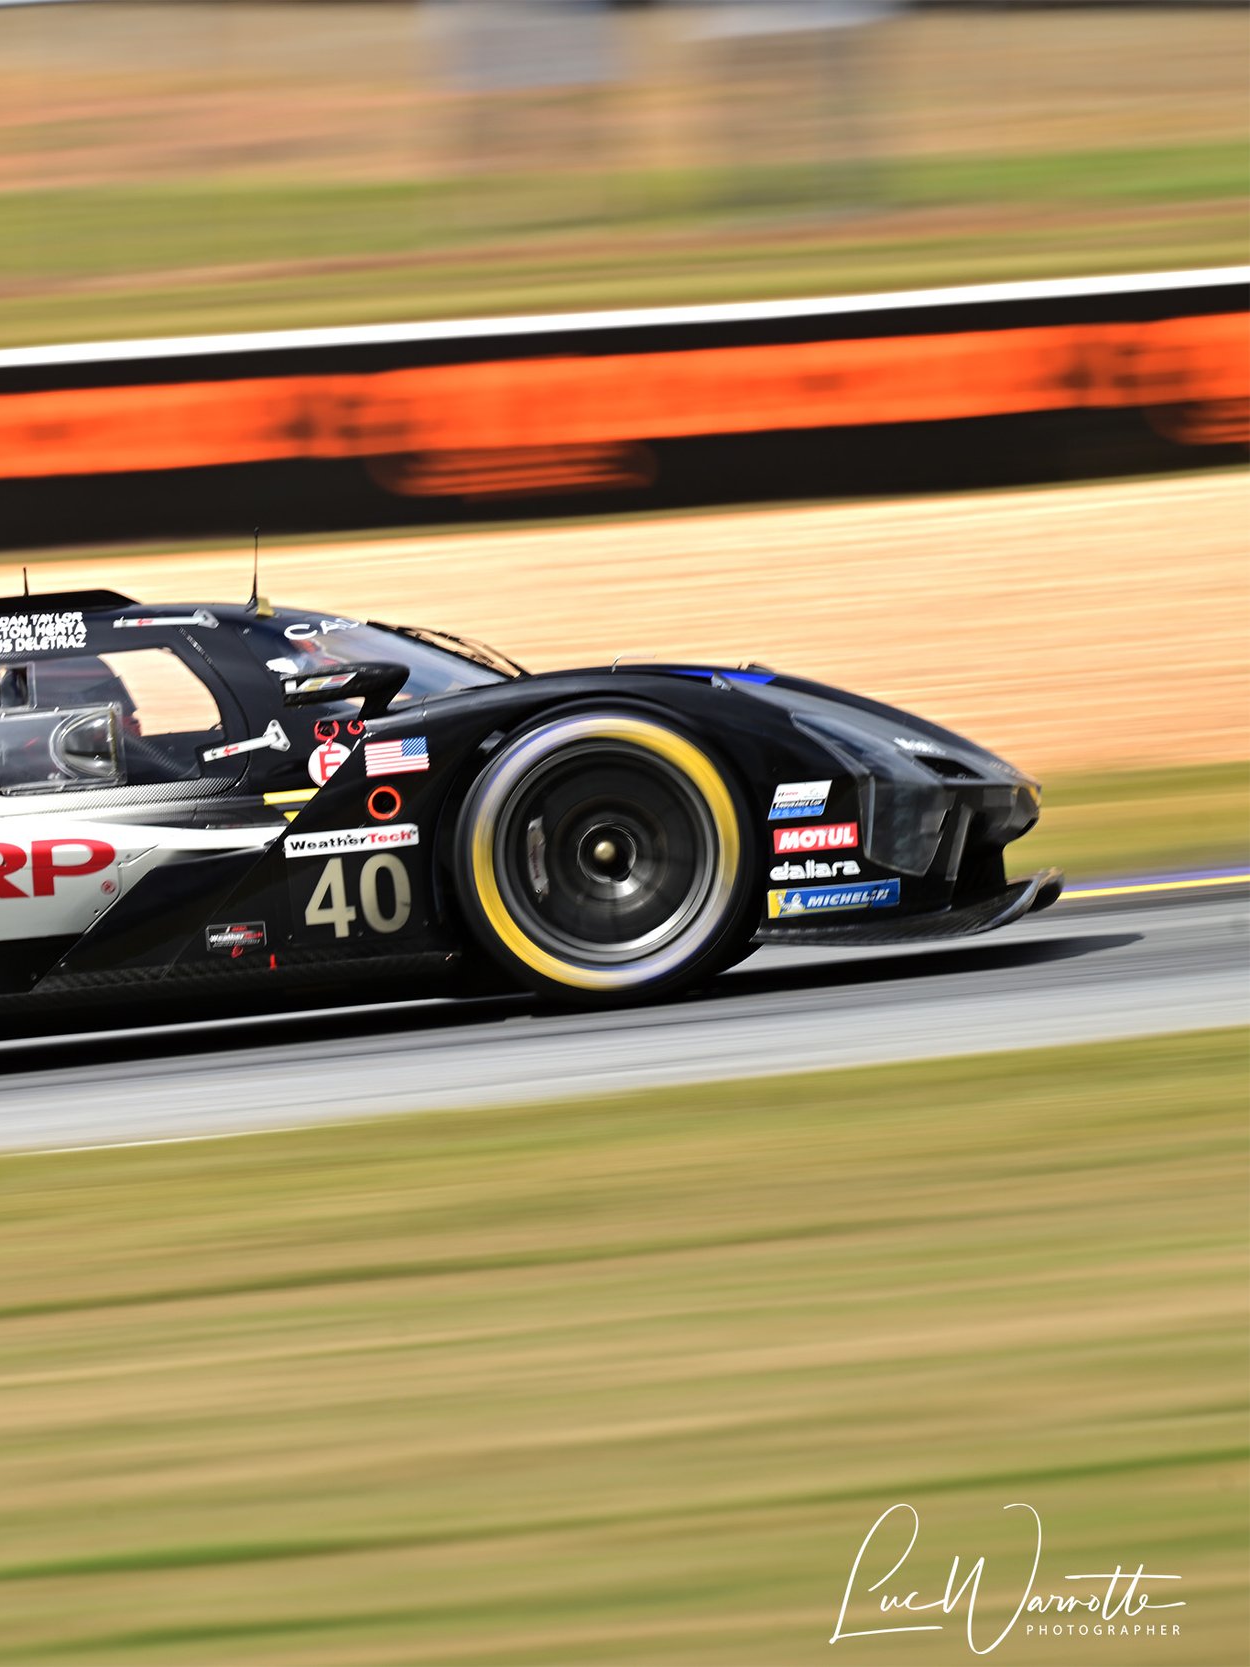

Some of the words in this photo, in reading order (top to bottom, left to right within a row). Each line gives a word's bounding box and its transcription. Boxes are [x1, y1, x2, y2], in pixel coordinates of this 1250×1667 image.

[30, 611, 83, 626] TAYLOR
[34, 621, 88, 637] HERTA
[15, 633, 87, 652] DELETRAZ
[290, 830, 411, 851] WeatherTech
[778, 827, 854, 850] MOTUL
[770, 859, 861, 881] dallara
[305, 853, 411, 938] 40
